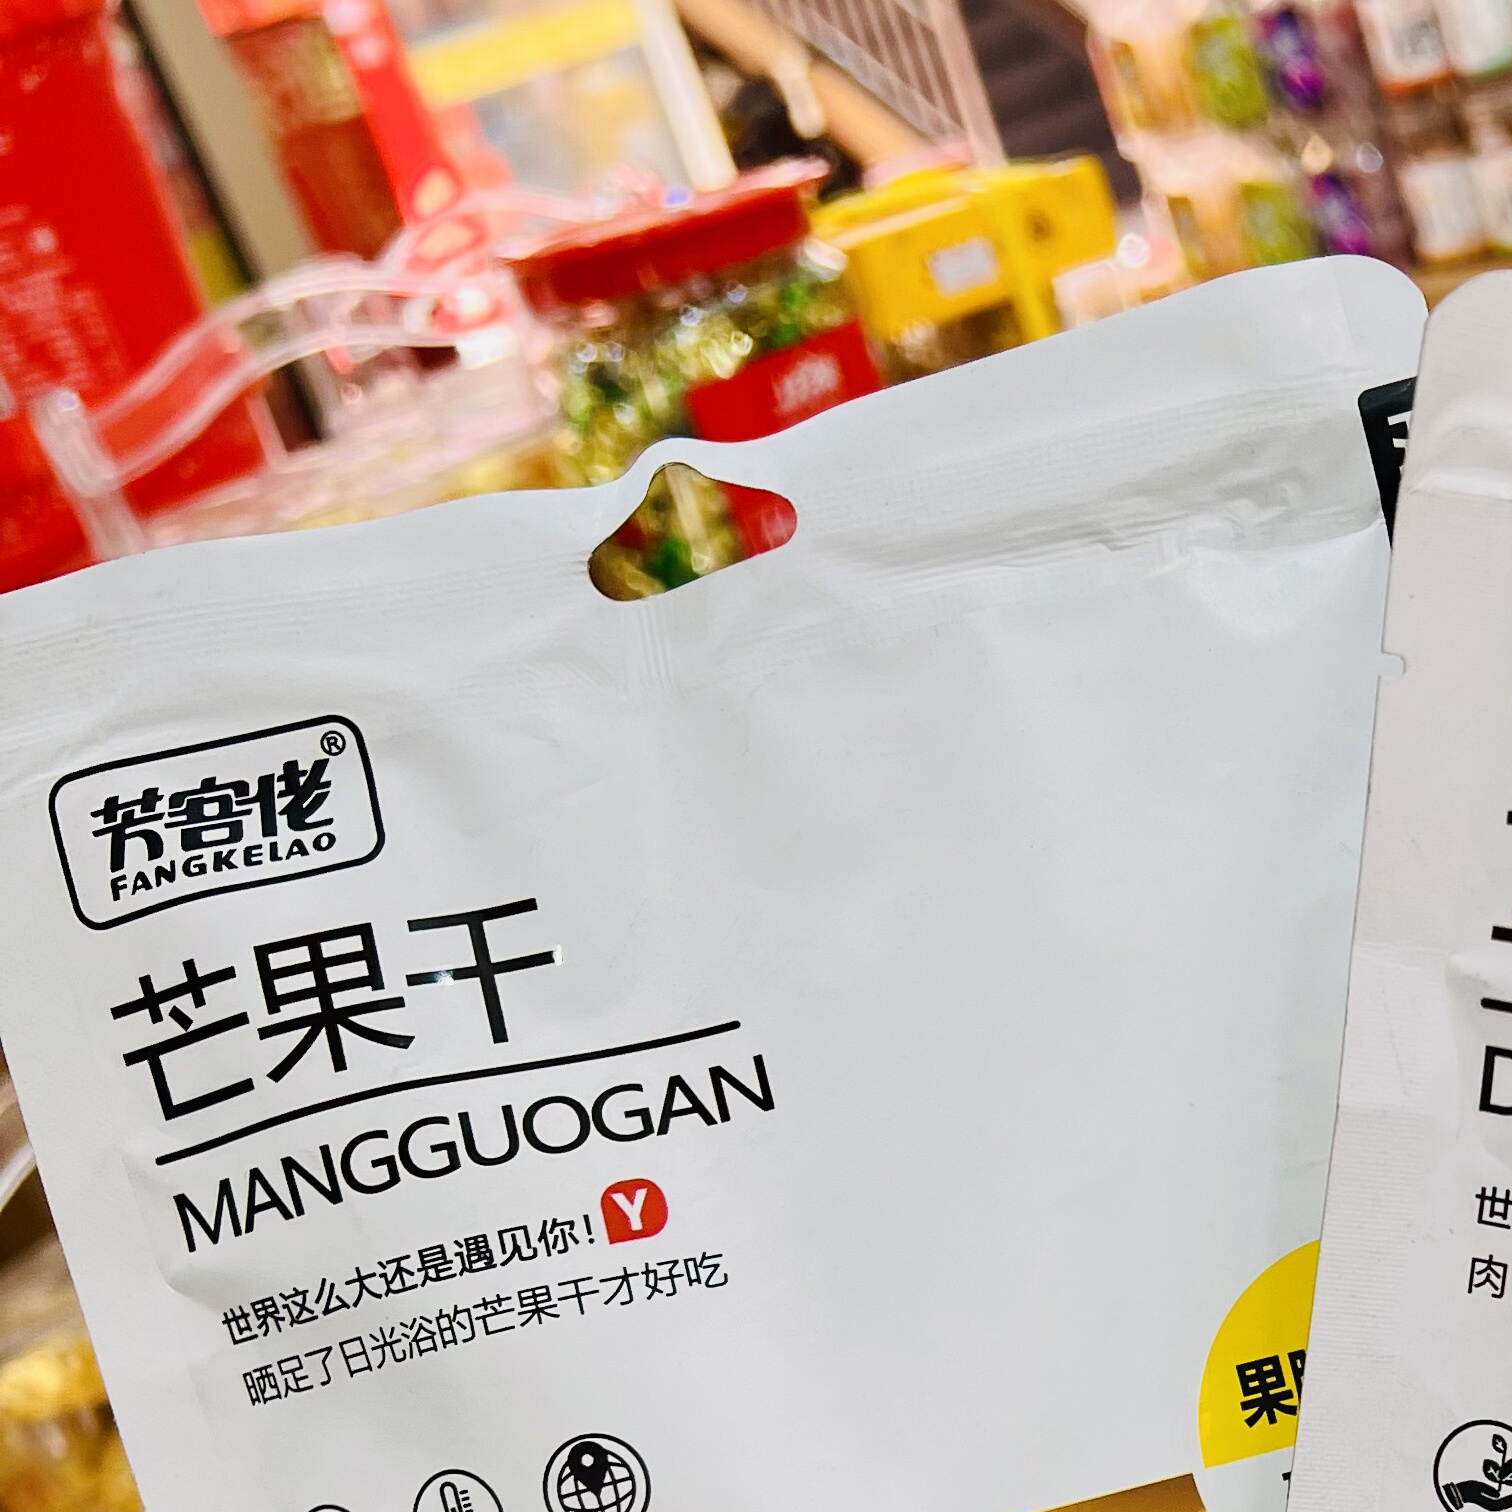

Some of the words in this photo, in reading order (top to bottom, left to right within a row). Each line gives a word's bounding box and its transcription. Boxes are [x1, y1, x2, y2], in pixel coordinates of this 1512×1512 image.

[90, 758, 334, 873] 芳客佬
[110, 831, 337, 902] FANGKELAO
[110, 898, 560, 1121] 芒果干
[173, 1054, 776, 1253] MANGGUOGAN
[242, 1251, 729, 1407] 晒足了日光浴的芒果干才好吃
